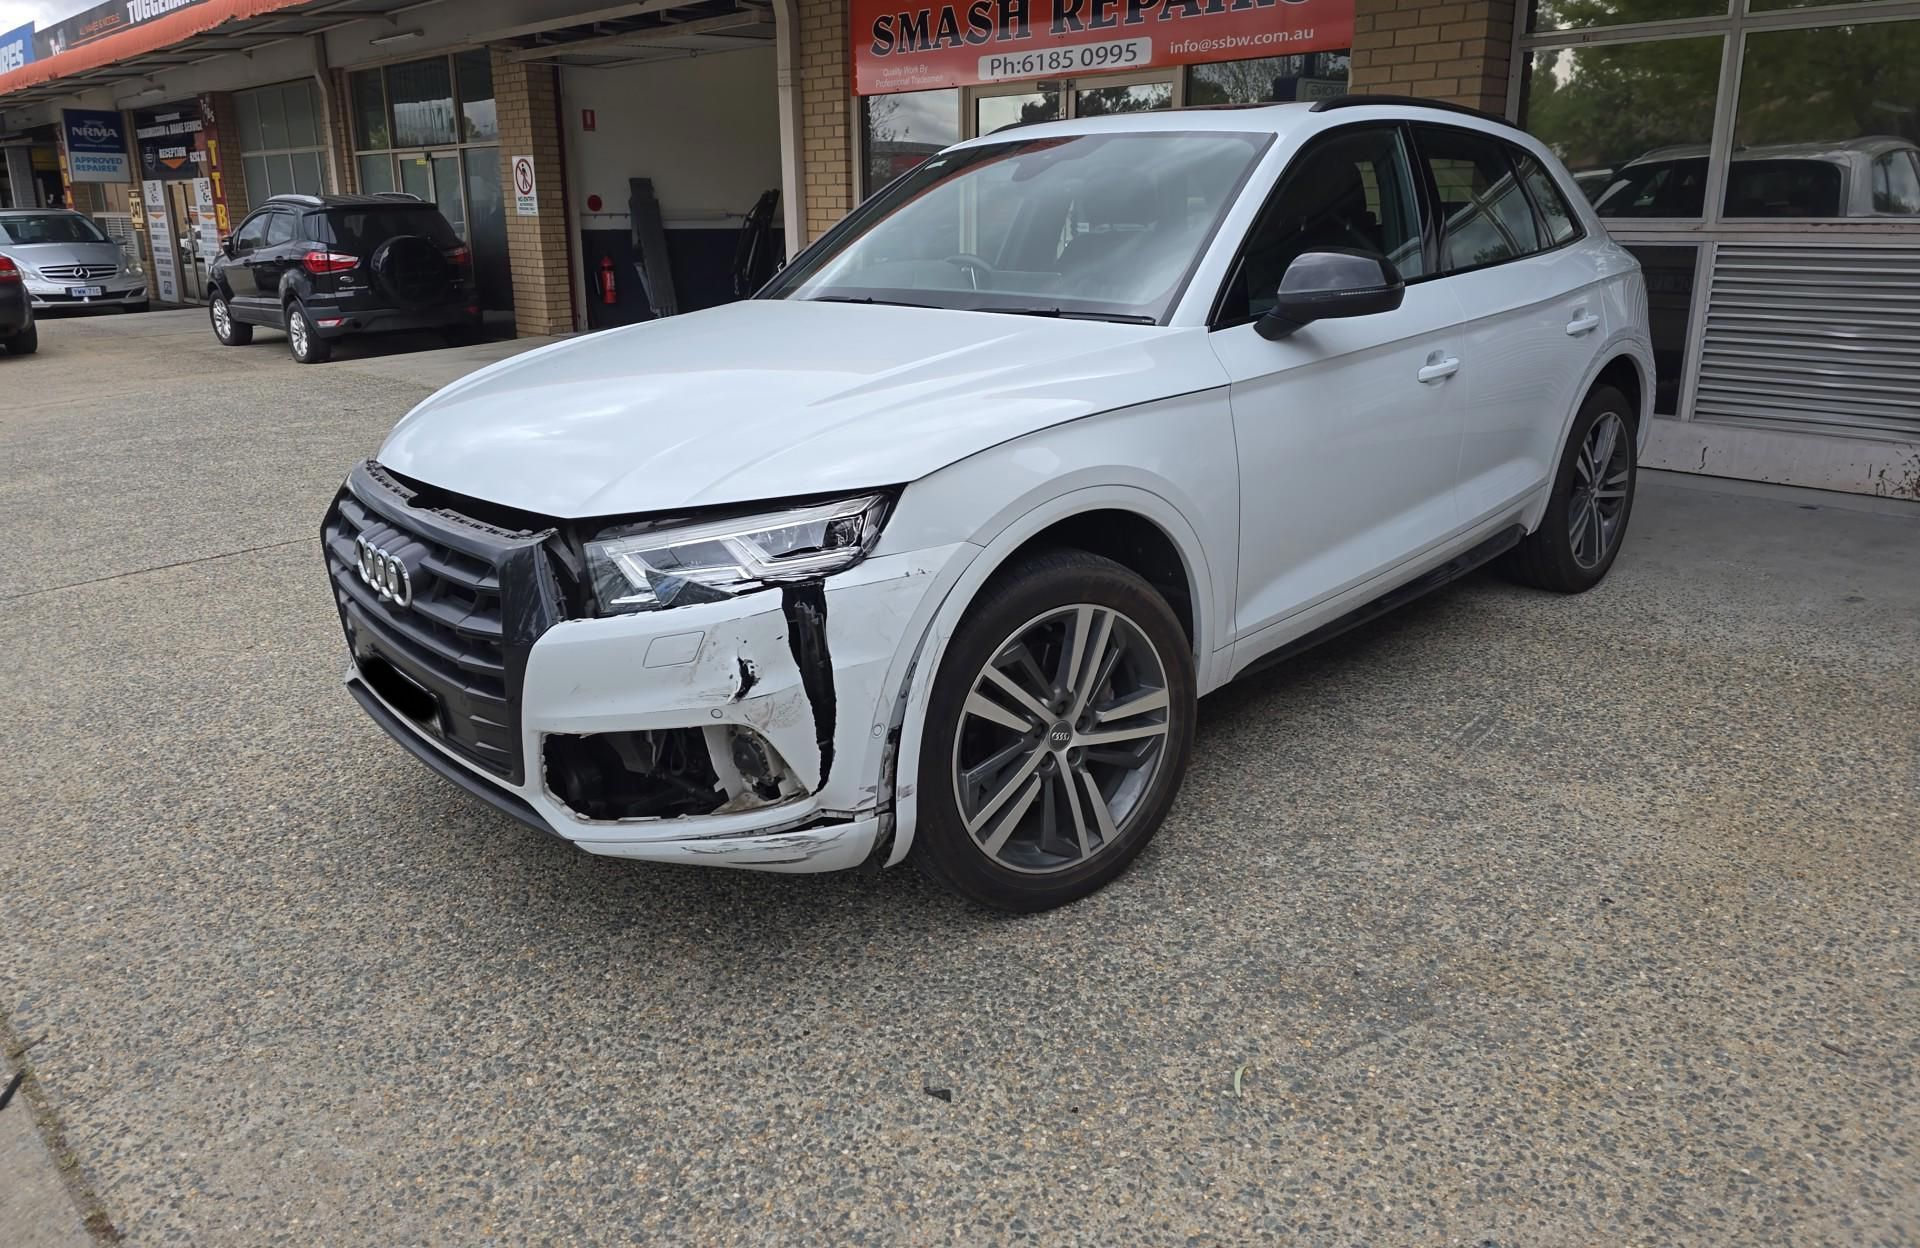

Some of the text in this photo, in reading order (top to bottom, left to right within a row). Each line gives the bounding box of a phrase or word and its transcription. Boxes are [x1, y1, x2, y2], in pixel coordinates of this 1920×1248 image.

[870, 0, 1309, 57] SMASH REPA
[1170, 28, 1314, 54] info@ssbw.com.au
[990, 43, 1137, 75] Ph:6185 0995
[882, 64, 928, 77] Quality Work By
[875, 78, 910, 88] Professional
[71, 126, 119, 138] NRMA
[74, 156, 123, 165] APPROVED
[75, 164, 118, 172] REPAIRER
